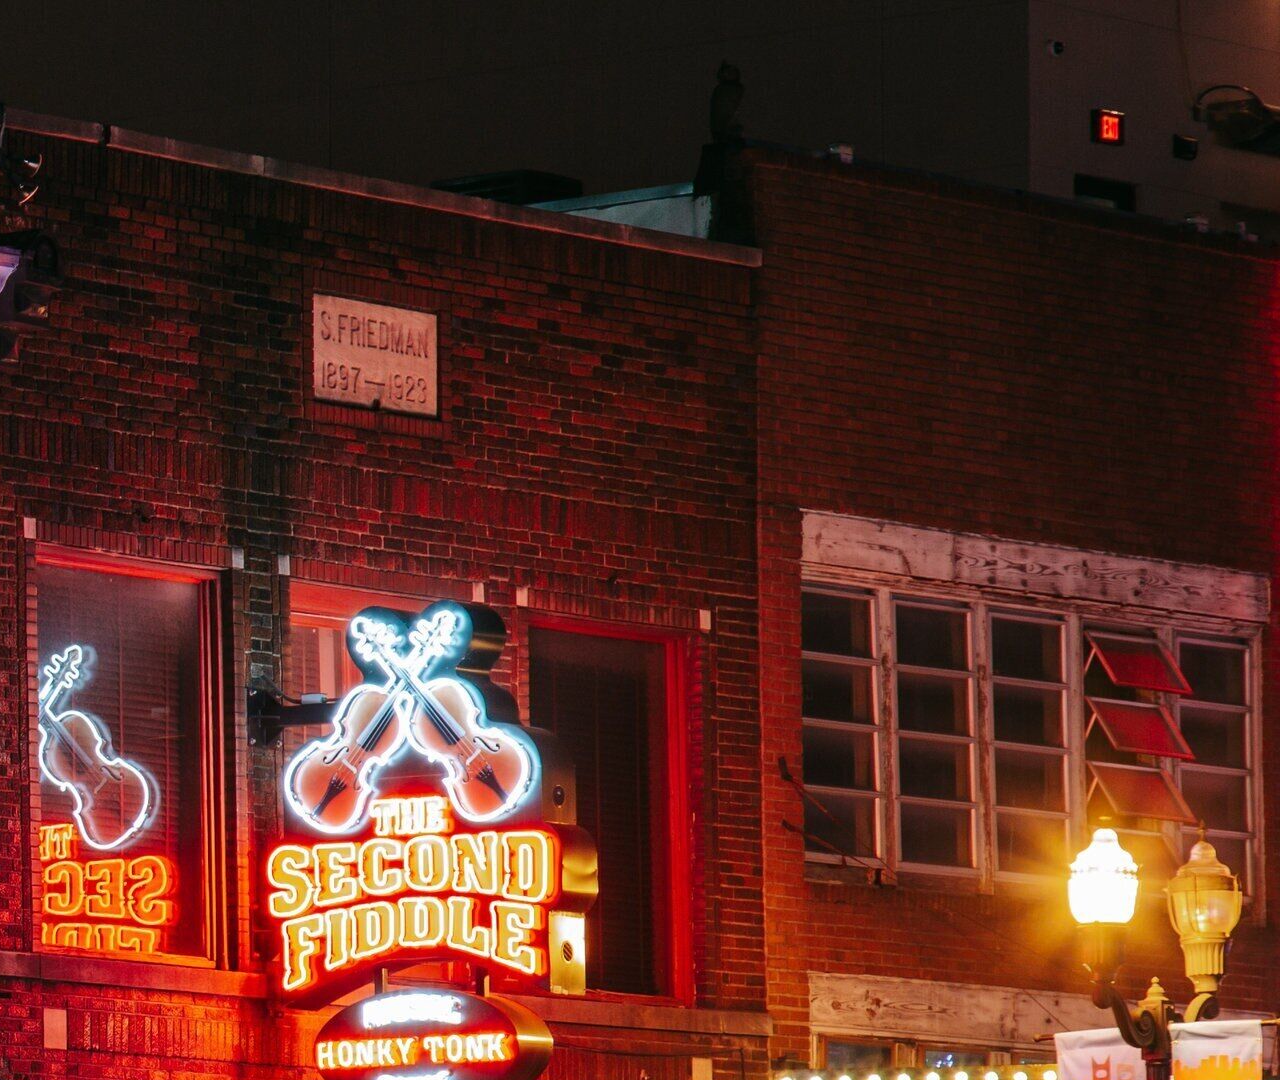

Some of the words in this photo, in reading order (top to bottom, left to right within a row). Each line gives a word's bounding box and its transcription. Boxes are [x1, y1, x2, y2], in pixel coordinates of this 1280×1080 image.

[371, 797, 447, 836] THE
[267, 829, 558, 918] SECOND
[282, 897, 544, 991] FIDDLE
[316, 1036, 420, 1070] HONKY
[422, 1031, 512, 1064] TONK
